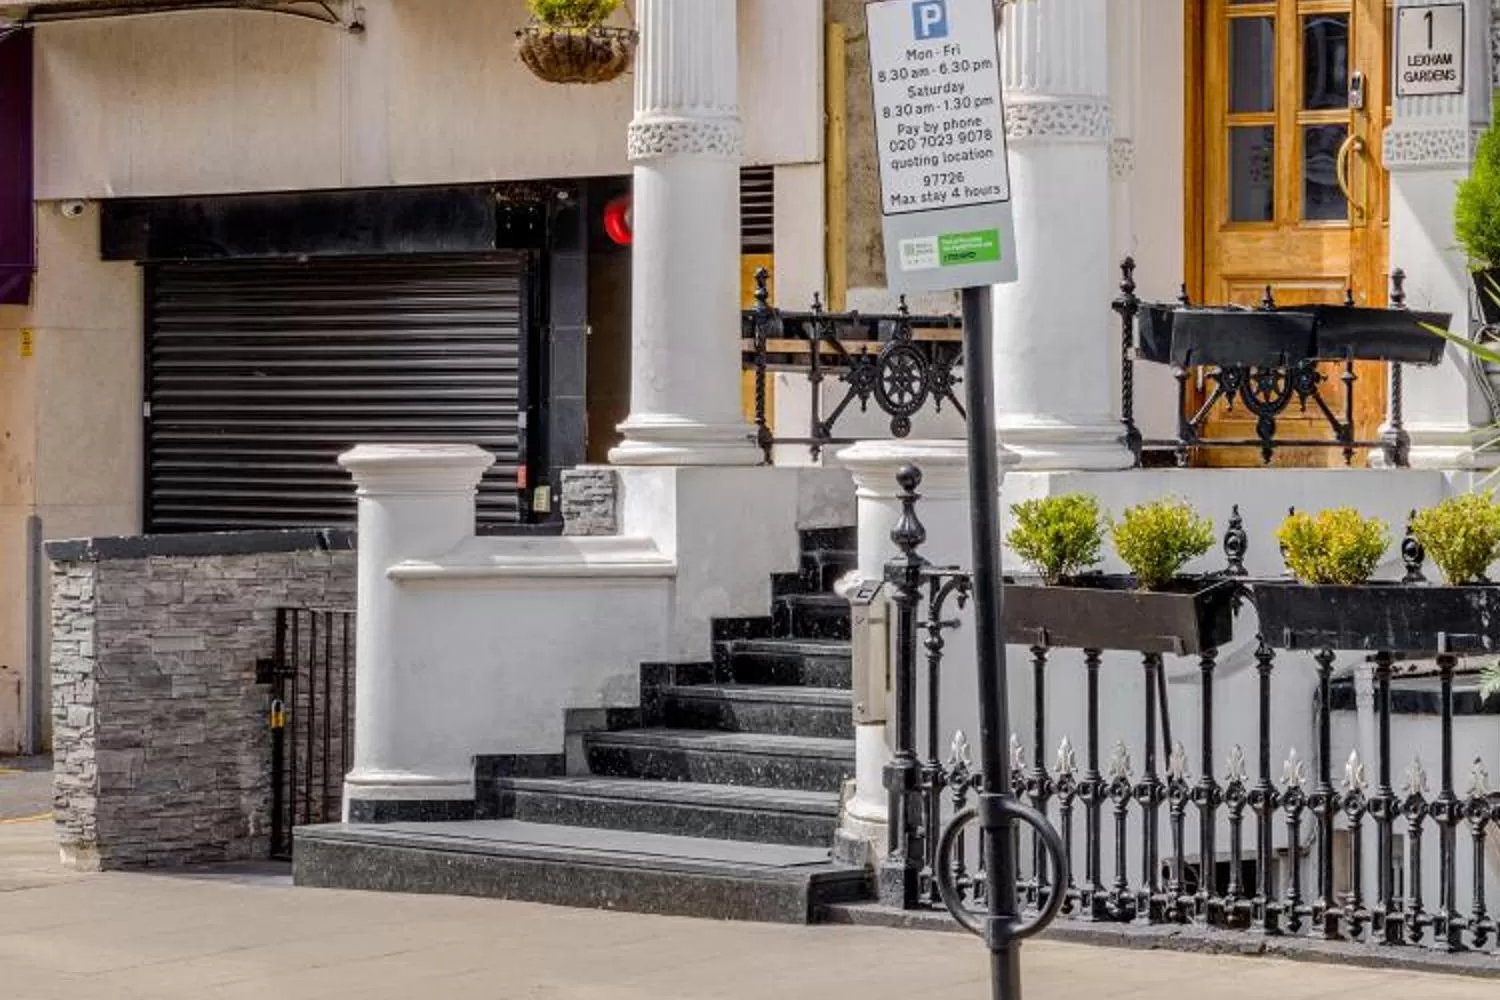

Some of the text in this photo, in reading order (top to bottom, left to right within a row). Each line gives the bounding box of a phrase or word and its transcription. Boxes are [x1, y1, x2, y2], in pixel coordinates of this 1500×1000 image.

[921, 3, 941, 37] P
[1424, 10, 1434, 50] 1
[906, 49, 933, 61] Mon
[943, 43, 961, 56] Fri
[1407, 53, 1453, 67] LEXHAM
[878, 67, 909, 83] 8.30
[911, 67, 929, 79] am
[940, 60, 970, 75] 6.30
[972, 59, 993, 72] pm
[1403, 69, 1457, 83] GARDENS
[907, 82, 965, 98] Saturday
[882, 103, 913, 118] 8.30
[915, 103, 935, 115] am
[943, 96, 971, 111] 1.30
[974, 96, 994, 108] pm
[897, 117, 982, 136] Pay by phone
[889, 128, 993, 152] 020 7023 9078
[891, 147, 993, 171] quoting location
[923, 171, 964, 187] 97726
[890, 185, 1001, 206] Max stay 4 hours
